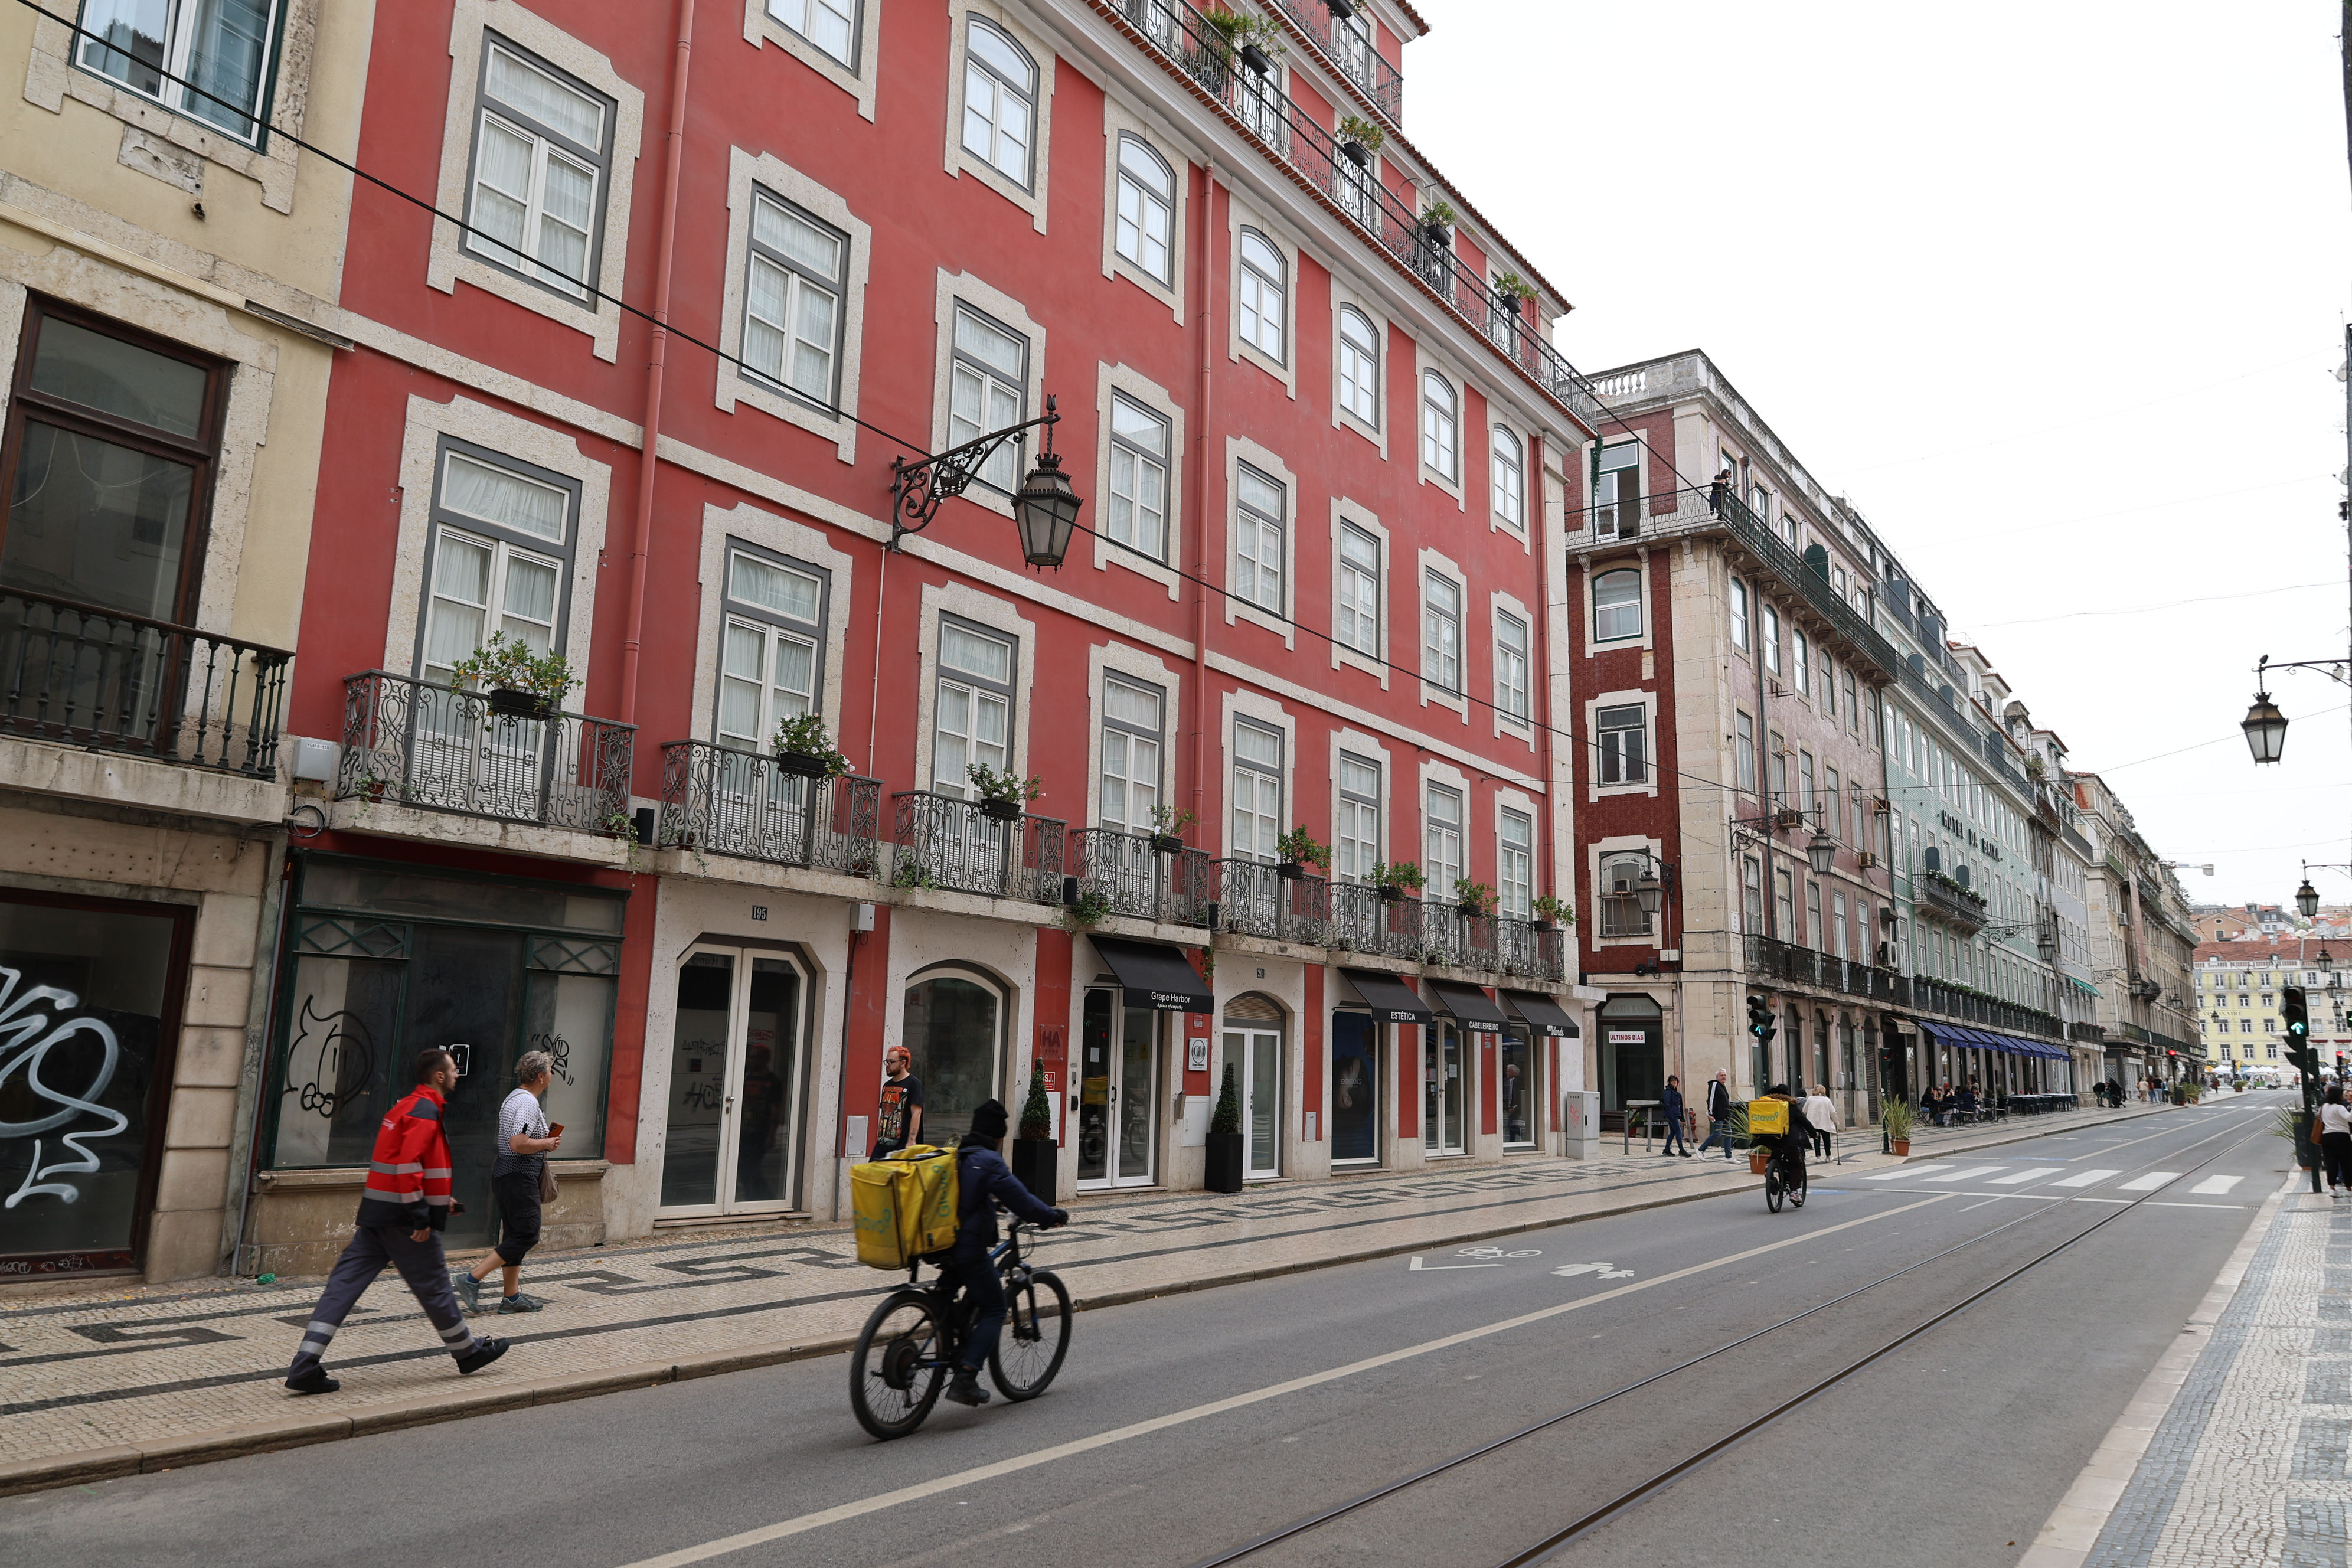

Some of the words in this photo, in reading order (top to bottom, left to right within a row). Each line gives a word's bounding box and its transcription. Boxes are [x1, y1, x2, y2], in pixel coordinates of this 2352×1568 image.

[1942, 809, 1964, 838] HOTEL
[1968, 829, 1978, 848] DA
[753, 907, 766, 920] 195
[1151, 991, 1170, 1002] Grape
[1171, 993, 1191, 1004] Harbor
[1391, 1010, 1416, 1021] ESTÉTICA
[1469, 1021, 1499, 1031] CABELEIREIRO
[1042, 1030, 1060, 1047] HA
